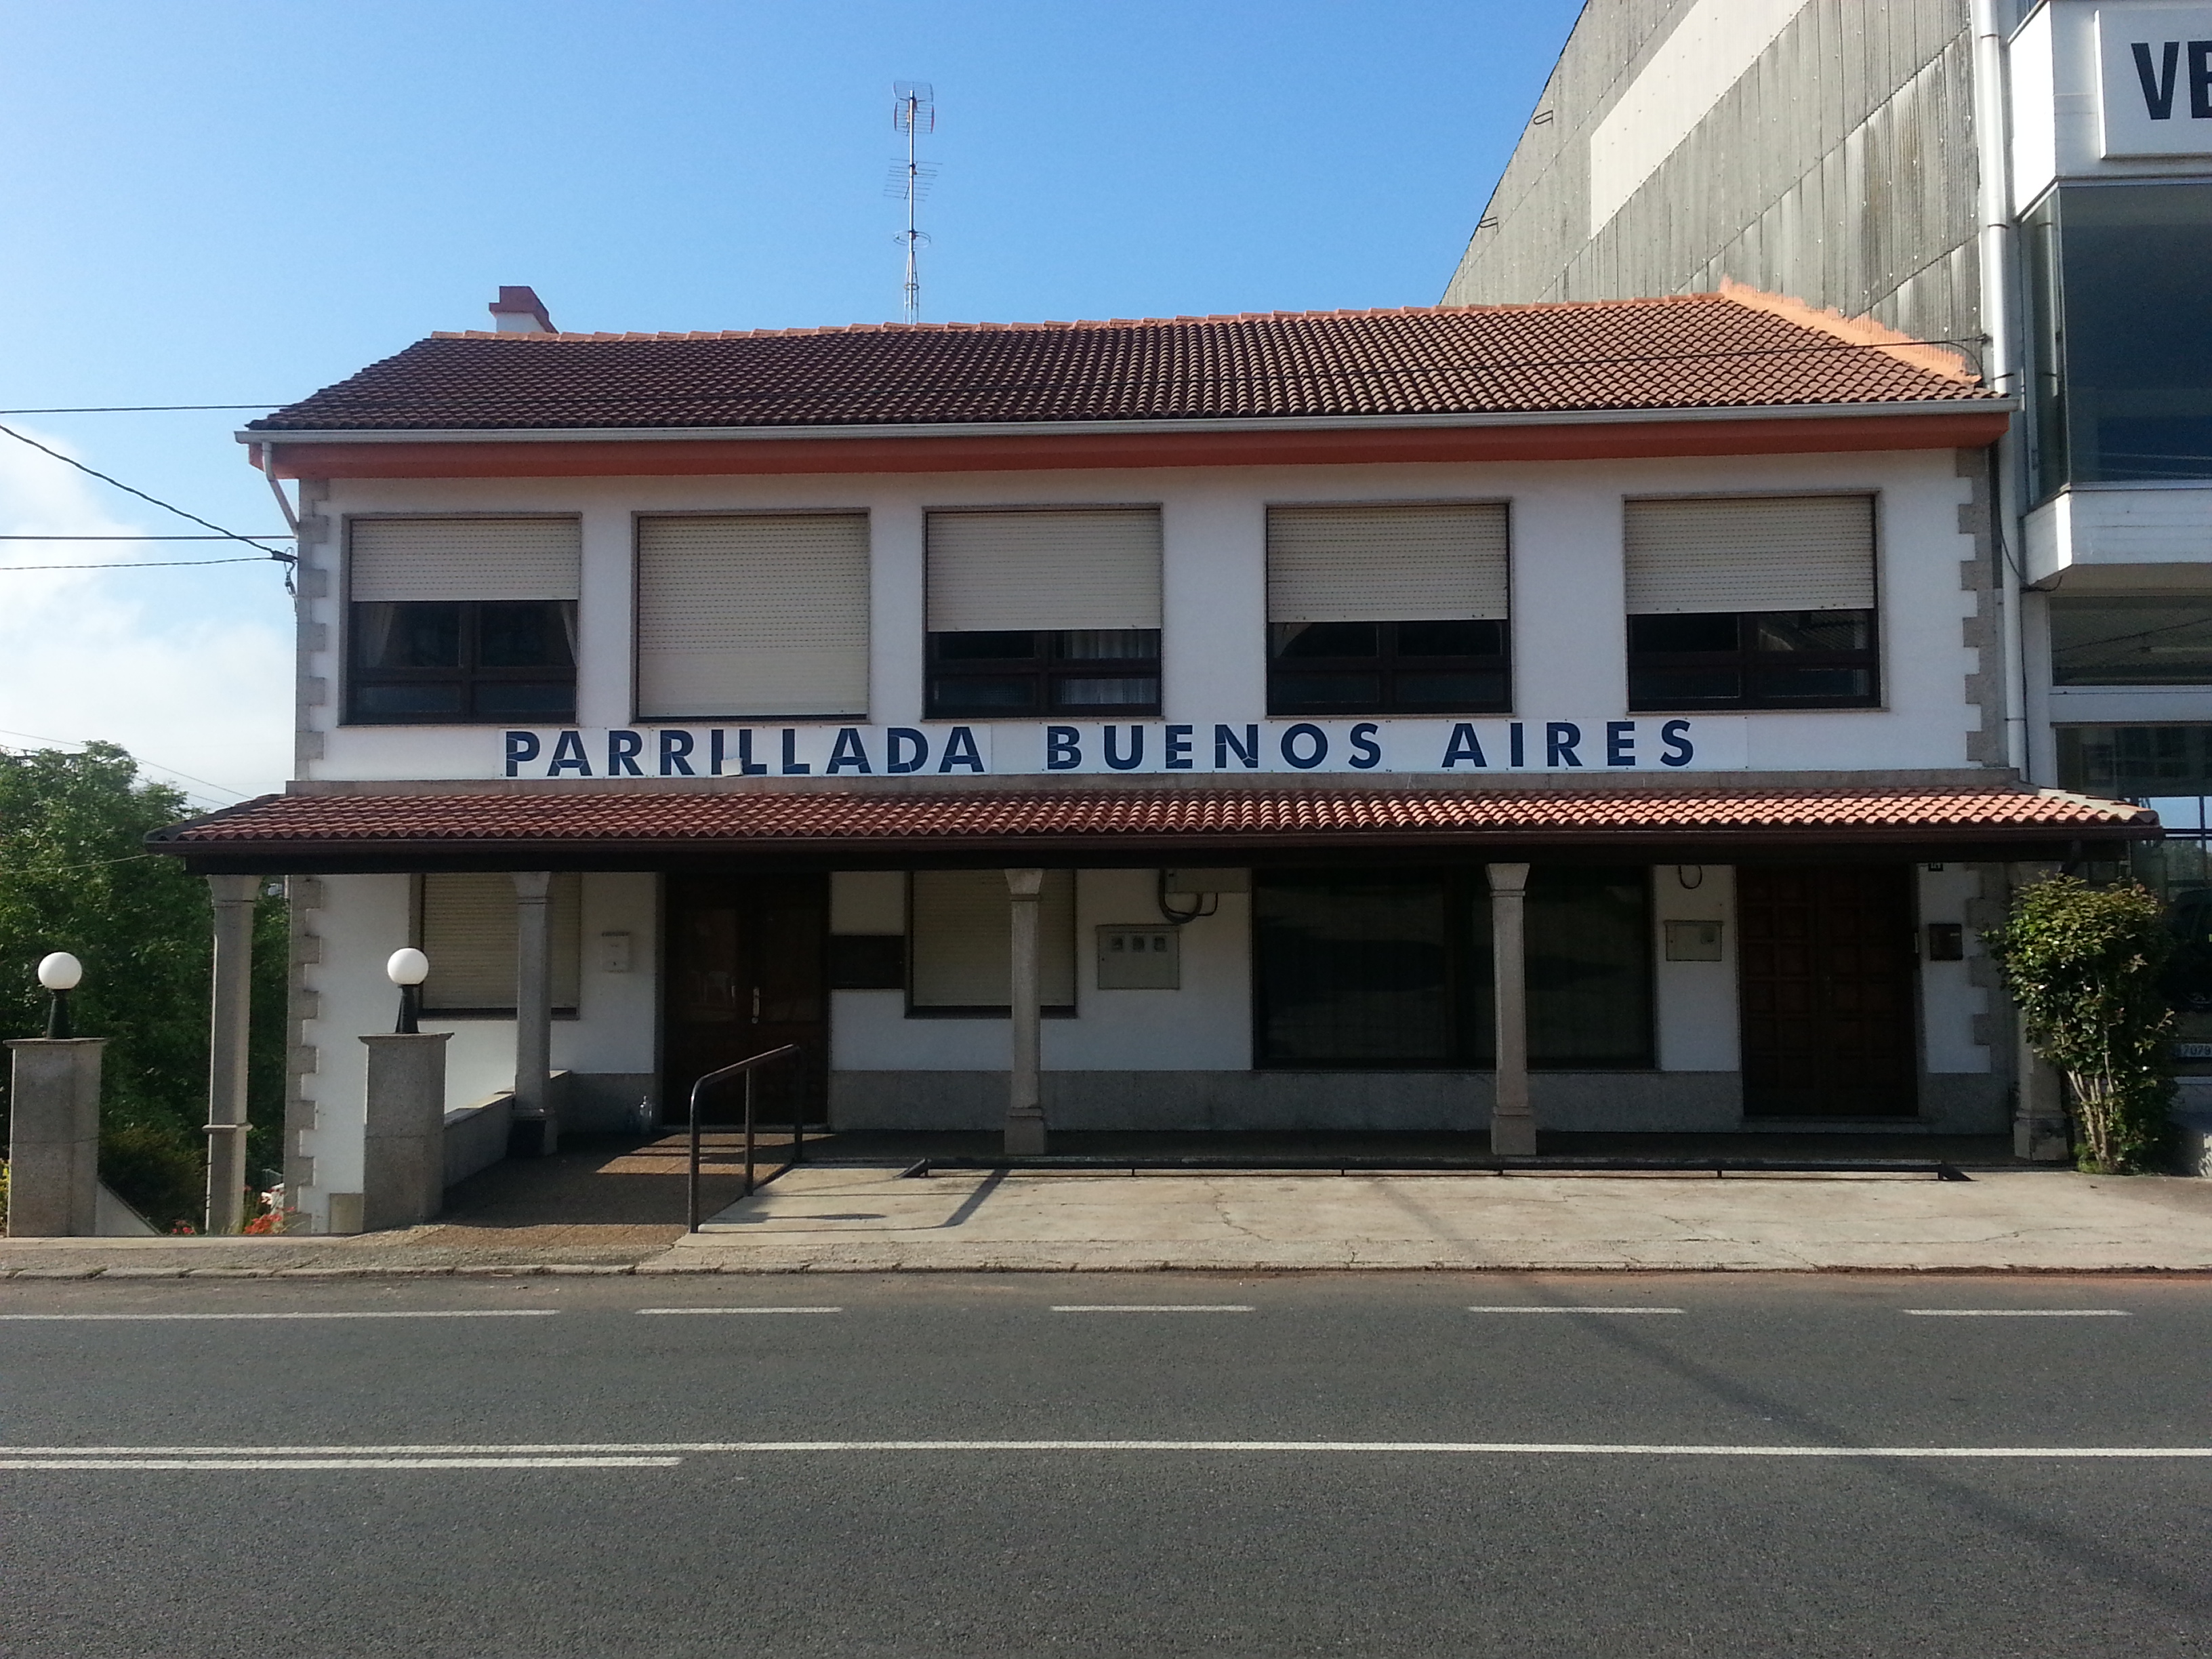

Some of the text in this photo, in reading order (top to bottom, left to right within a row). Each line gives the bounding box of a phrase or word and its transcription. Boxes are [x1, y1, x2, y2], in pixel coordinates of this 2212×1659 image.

[2131, 41, 2212, 120] VE
[505, 719, 1694, 777] PARRILLADA BUENOS AIRES
